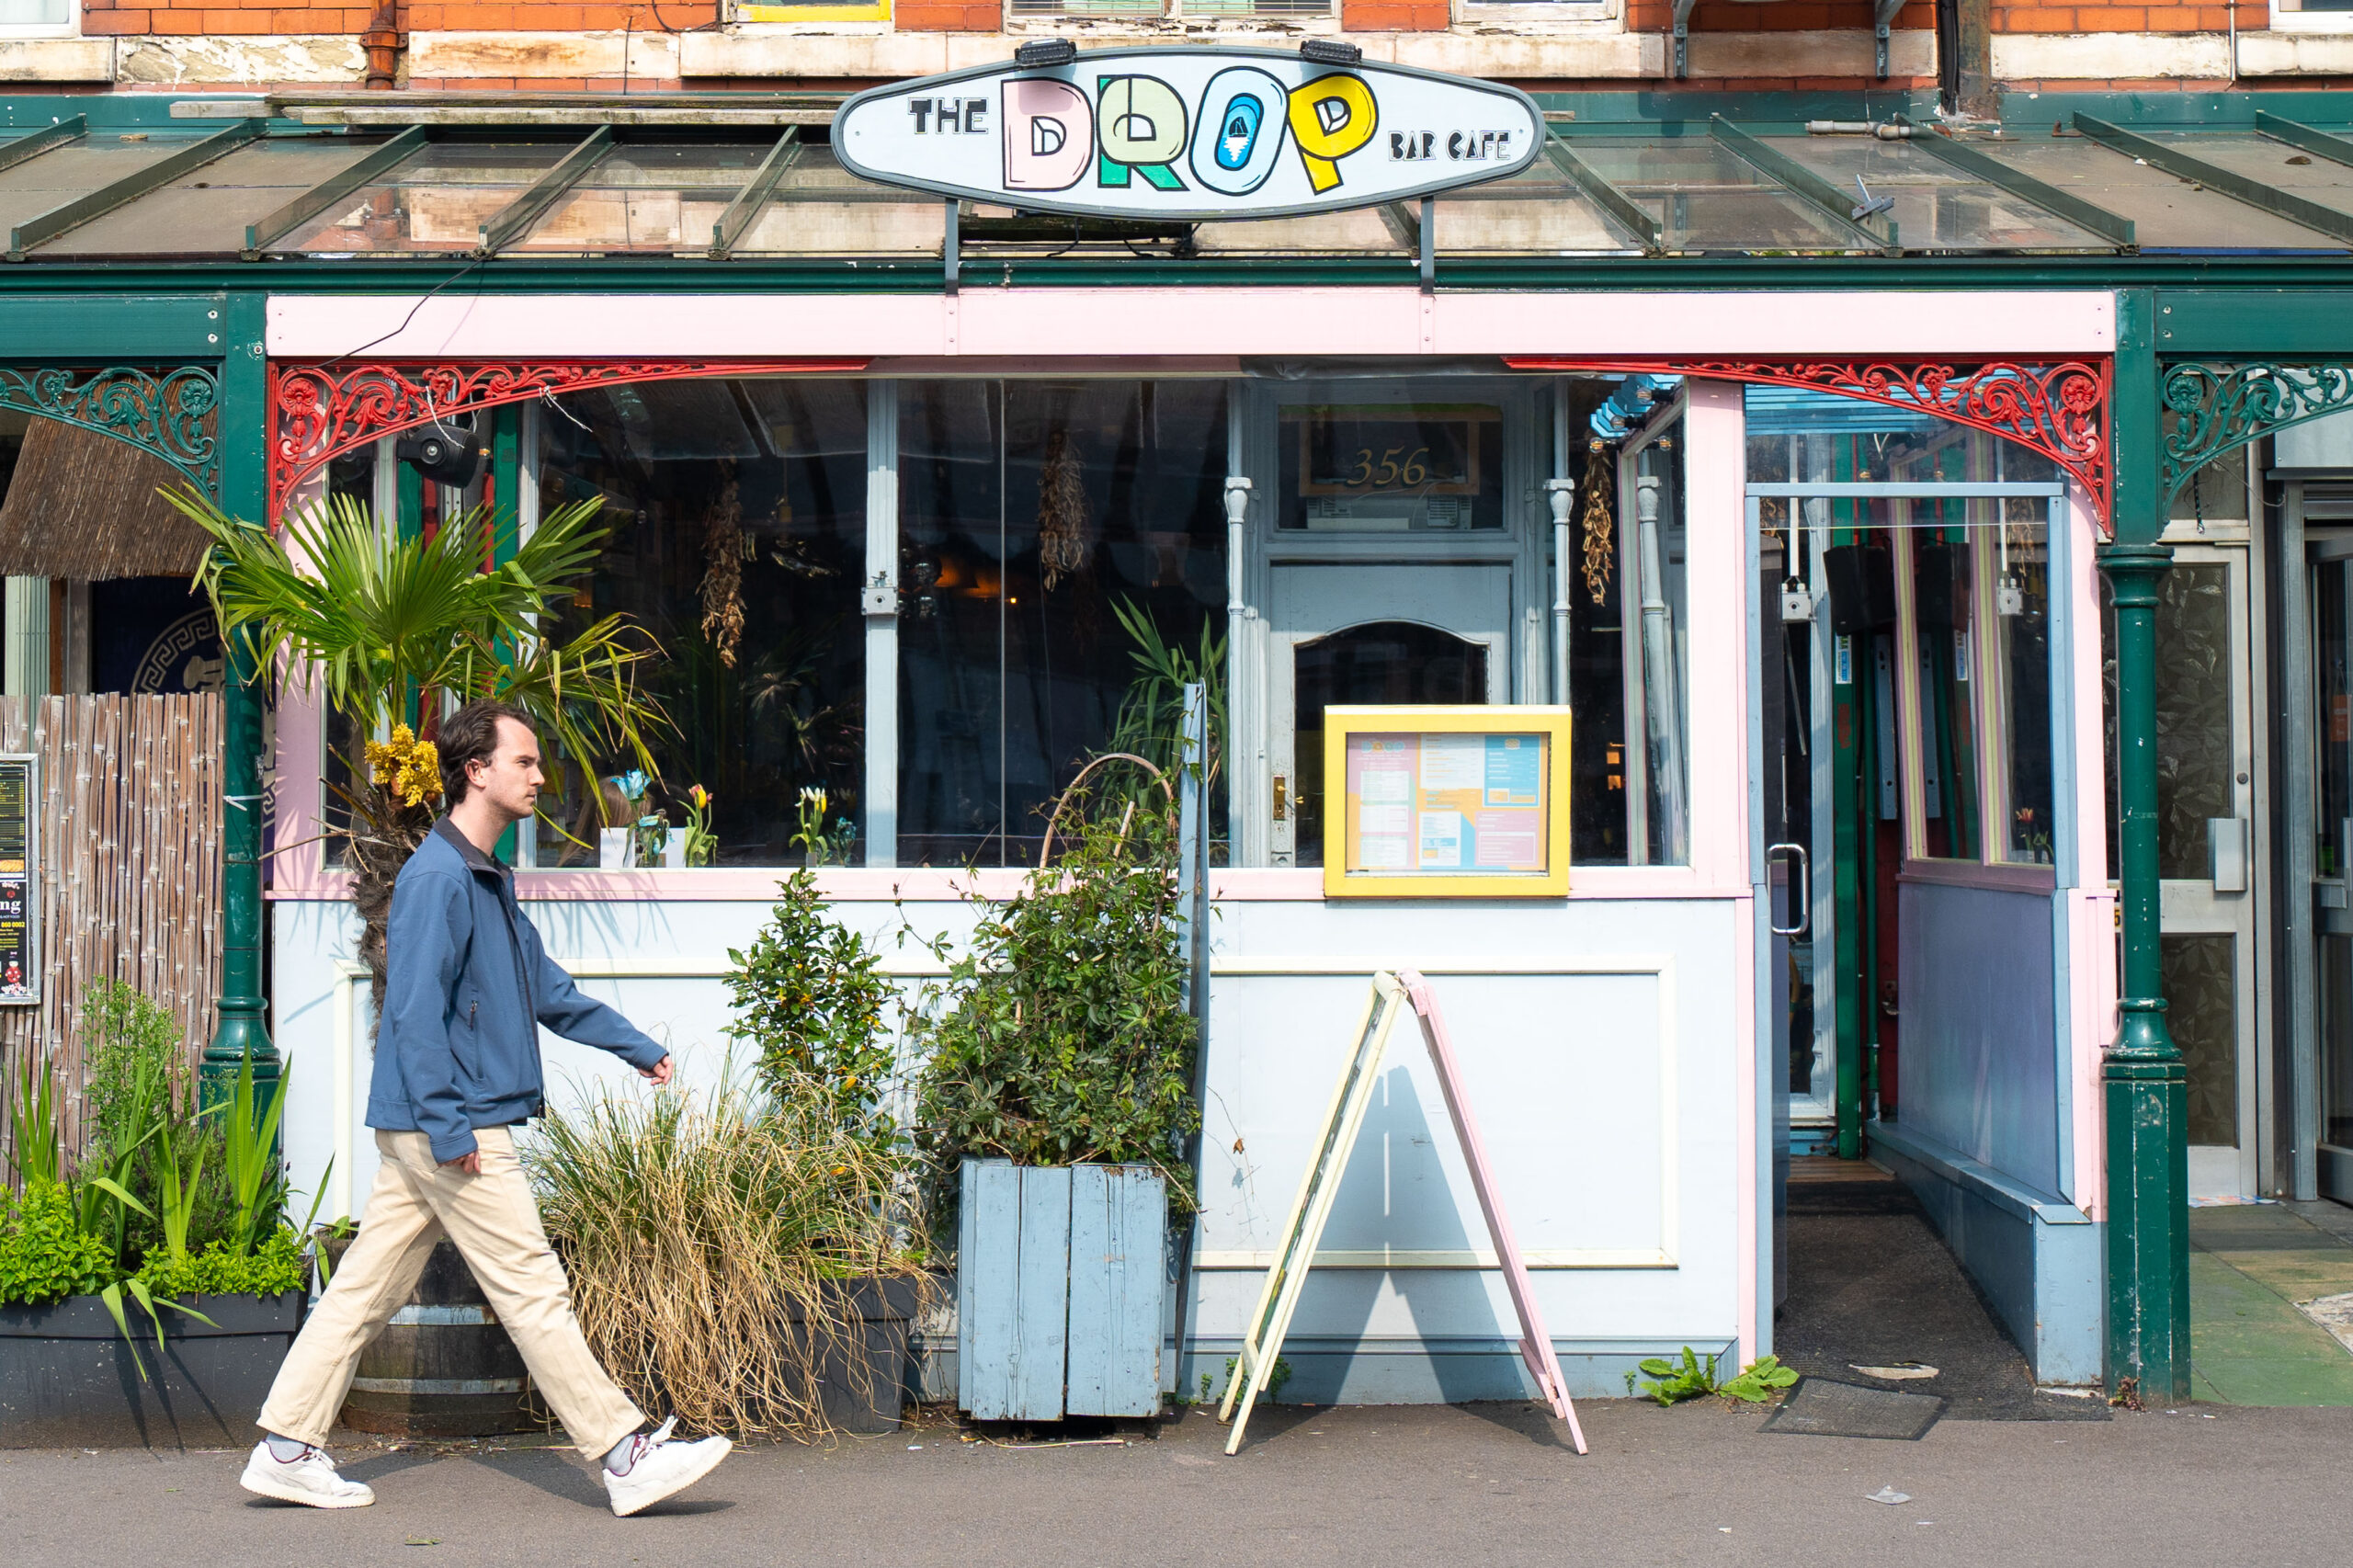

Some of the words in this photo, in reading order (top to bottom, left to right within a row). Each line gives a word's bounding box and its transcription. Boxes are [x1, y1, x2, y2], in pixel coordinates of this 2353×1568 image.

[908, 97, 989, 134] THE
[1001, 66, 1380, 196] DROP
[1389, 130, 1437, 161] BAR
[1446, 129, 1511, 161] CAFE
[1347, 446, 1429, 485] 356
